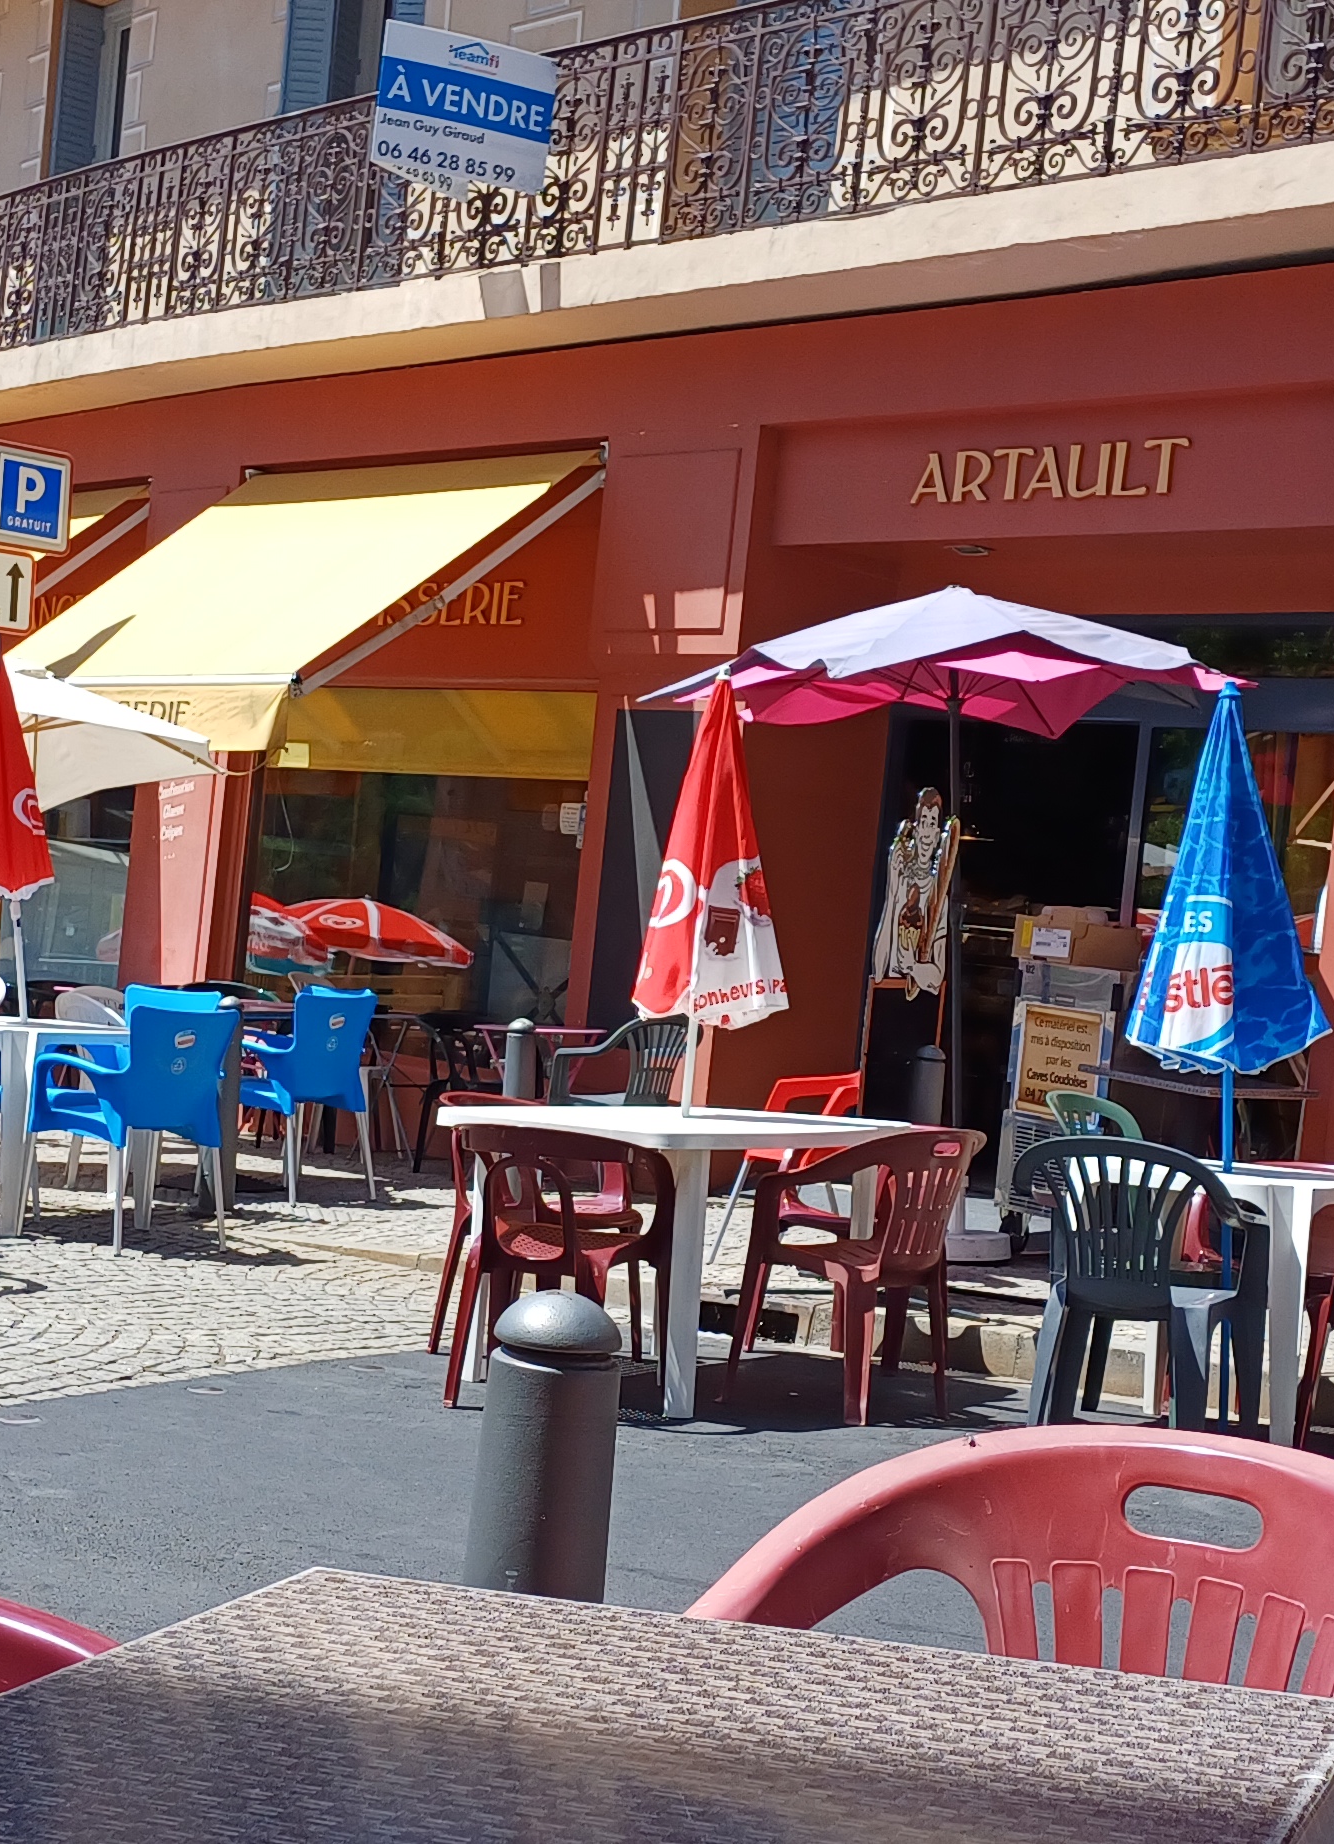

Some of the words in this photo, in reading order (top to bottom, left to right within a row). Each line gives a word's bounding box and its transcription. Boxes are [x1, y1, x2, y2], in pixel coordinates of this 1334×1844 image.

[387, 65, 412, 103] À
[421, 78, 546, 133] VENDRE
[379, 113, 410, 129] Jean
[413, 119, 441, 137] Guy
[377, 140, 402, 159] 06
[407, 147, 432, 165] 46
[436, 151, 460, 171] 28
[465, 158, 488, 177] 85
[492, 164, 516, 183] 99
[910, 437, 1190, 504] ARTAULT
[16, 465, 46, 514] P
[7, 515, 52, 533] GRATUIT
[1030, 1035, 1044, 1046] mis
[1050, 1037, 1091, 1053] disposition
[1045, 1056, 1059, 1066] par
[1060, 1056, 1072, 1068] les
[1027, 1067, 1049, 1083] Caves
